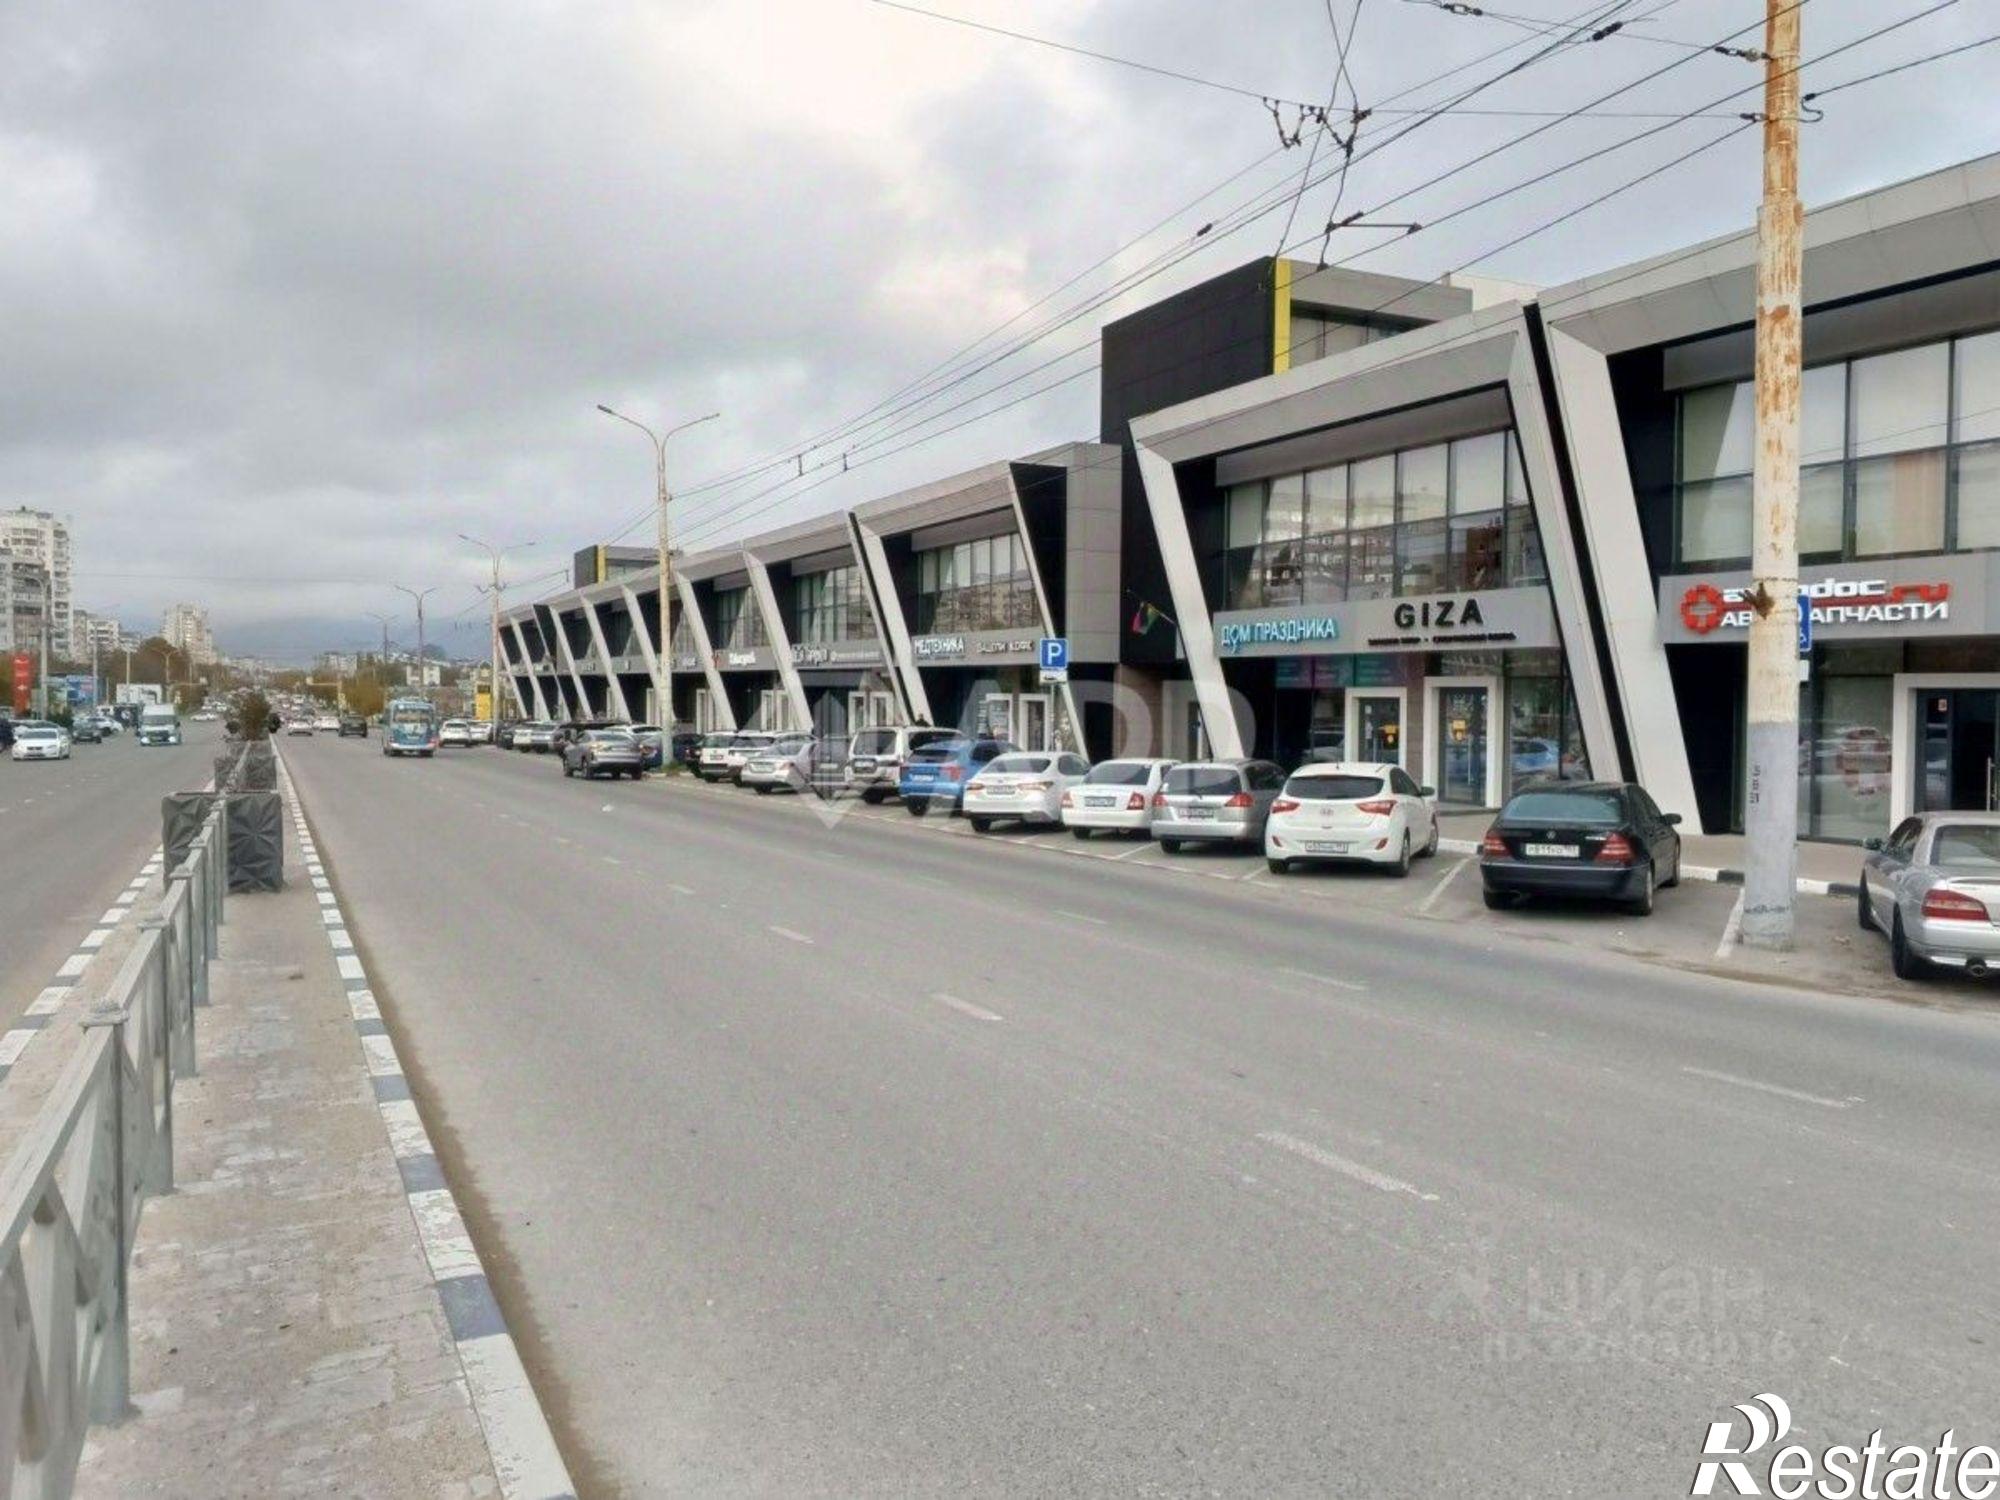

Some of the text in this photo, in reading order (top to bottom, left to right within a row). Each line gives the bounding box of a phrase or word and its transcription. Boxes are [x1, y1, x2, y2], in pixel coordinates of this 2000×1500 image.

[1394, 598, 1484, 628] GIZA
[1254, 620, 1336, 642] ПРАЗДНИКА
[1048, 643, 1062, 665] P
